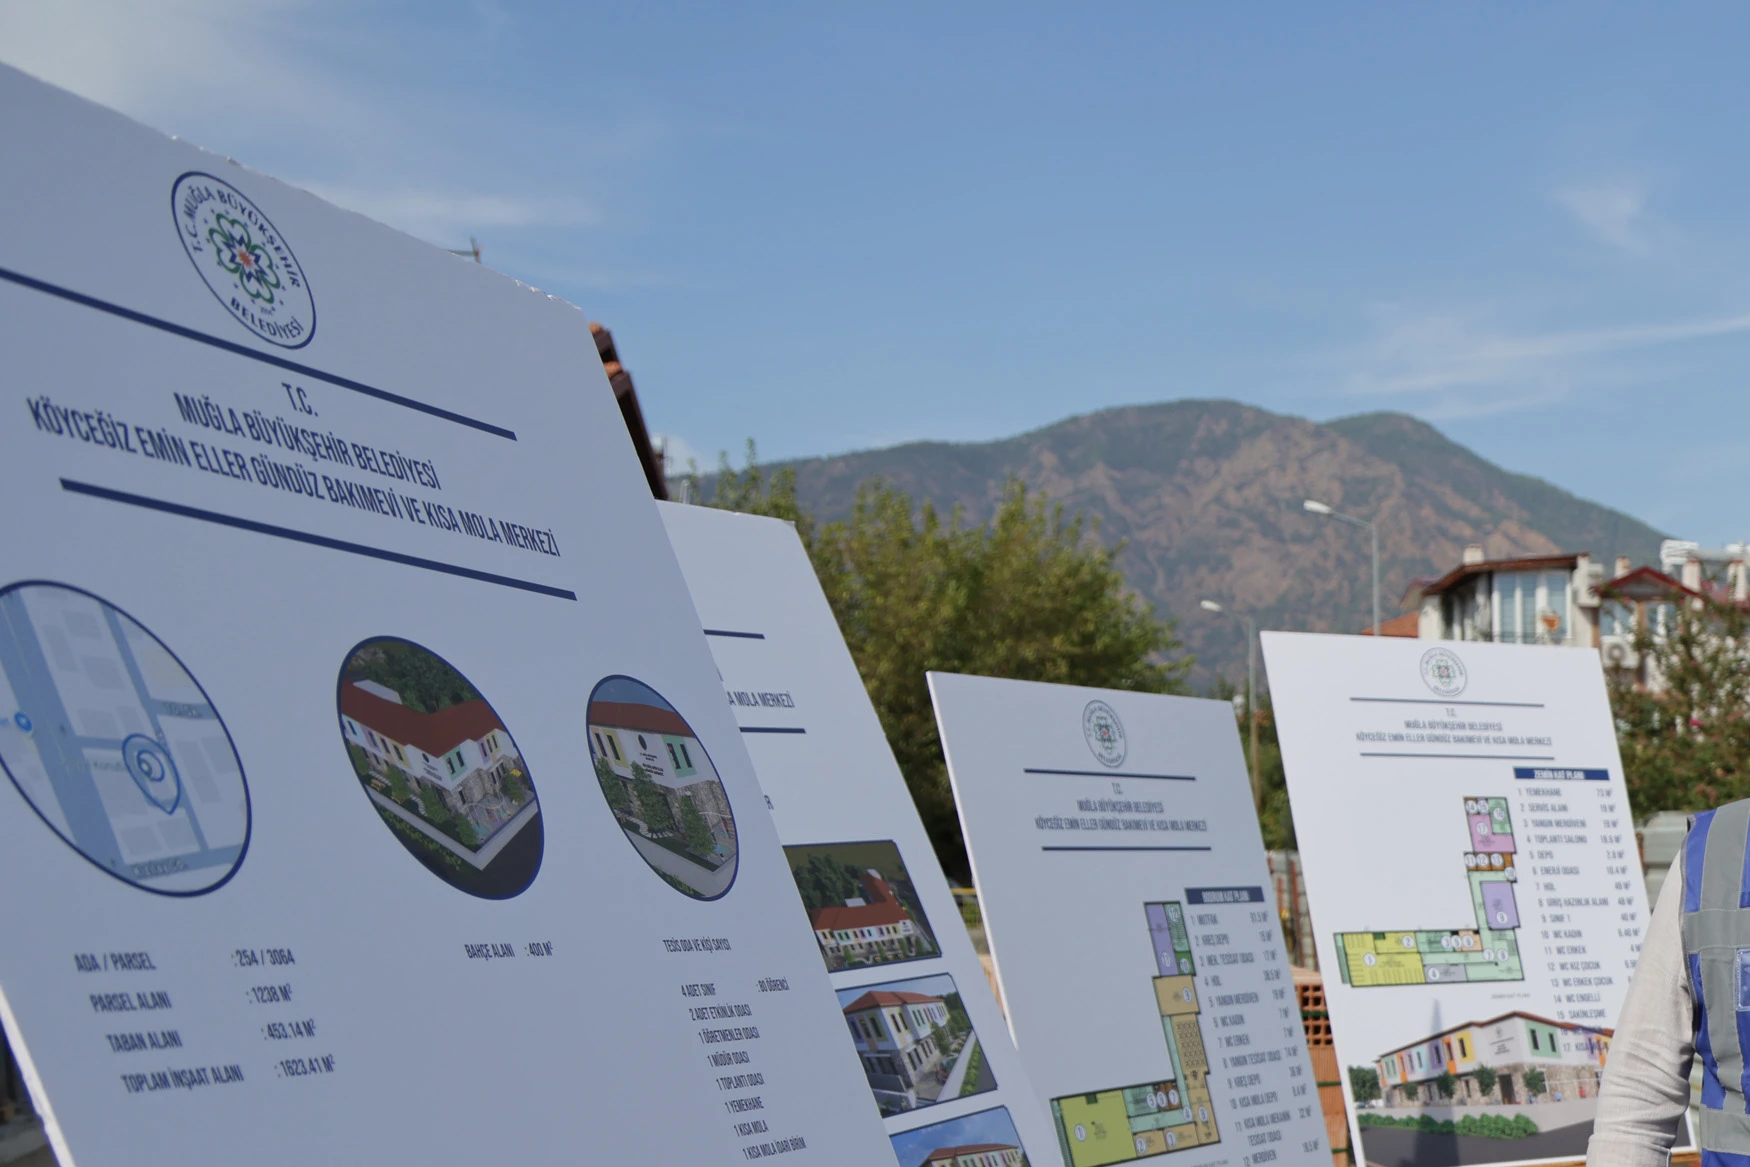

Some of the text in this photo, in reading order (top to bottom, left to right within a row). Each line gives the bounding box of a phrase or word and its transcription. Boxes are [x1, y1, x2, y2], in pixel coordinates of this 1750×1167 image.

[183, 184, 217, 222] MUĞLA
[216, 188, 301, 288] BÜYÜKŞEHİR
[230, 296, 304, 339] BELEDİYESİ
[281, 382, 319, 417] T.C.
[173, 391, 442, 490] MUĞLA BÜYÜKŞEHİR BELEDİYESİ
[26, 395, 561, 557] KÖYCEĞİZ EMİN ELLER GÜNDÜZ BAKIMEVİ VE KISA MOLA MERKEZİ
[733, 691, 761, 707] MOLA
[757, 690, 796, 709] MERKEZİ
[464, 943, 493, 961] BAHÇE
[493, 943, 516, 958] ALANI
[662, 936, 732, 953] TESİS ODA VE KİŞİ SAYISI
[73, 953, 101, 973] ADA
[110, 951, 157, 972] PARSEL
[266, 948, 295, 966] 3064
[681, 984, 687, 998] 4
[686, 983, 701, 997] ADET
[700, 983, 716, 996] SINIF
[764, 977, 790, 992] ÖĞRENCİ
[89, 992, 137, 1012] PARSEL
[137, 991, 172, 1010] ALANI
[689, 1003, 752, 1021] 2 ADET ETKİNLİK ODASI
[105, 1033, 147, 1053] TABAN
[148, 1030, 183, 1049] ALANI
[698, 1026, 760, 1044] 1 ÖĞRETMENLER ODASI
[707, 1050, 750, 1068] 1 MÜDÜR ODASI
[120, 1071, 171, 1094] TOPLAM
[168, 1066, 210, 1091] İNŞAAT
[210, 1064, 245, 1083] ALANI
[716, 1072, 765, 1091] 1 TOPLANTI ODASI
[725, 1096, 764, 1114] 1 YEMEKHANE
[734, 1119, 769, 1137] 1 KISA MOLA
[742, 1148, 749, 1160] 1
[746, 1145, 762, 1160] KISA
[759, 1142, 777, 1157] MOLA
